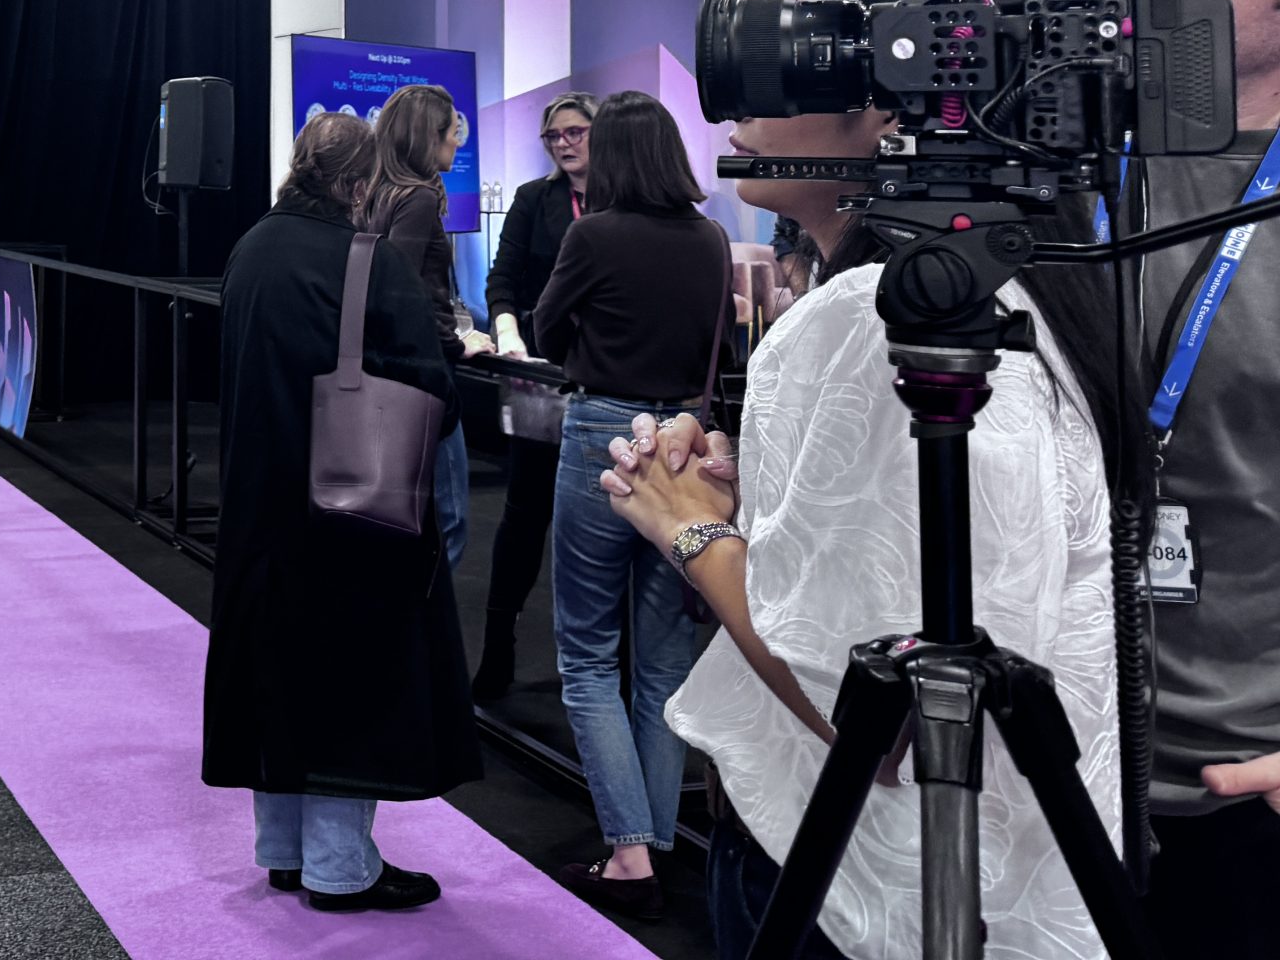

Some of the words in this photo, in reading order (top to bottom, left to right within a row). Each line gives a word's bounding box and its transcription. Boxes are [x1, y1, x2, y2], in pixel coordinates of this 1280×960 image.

[1206, 262, 1230, 298] Elevators
[1203, 297, 1213, 305] &
[1187, 304, 1210, 347] Escalators
